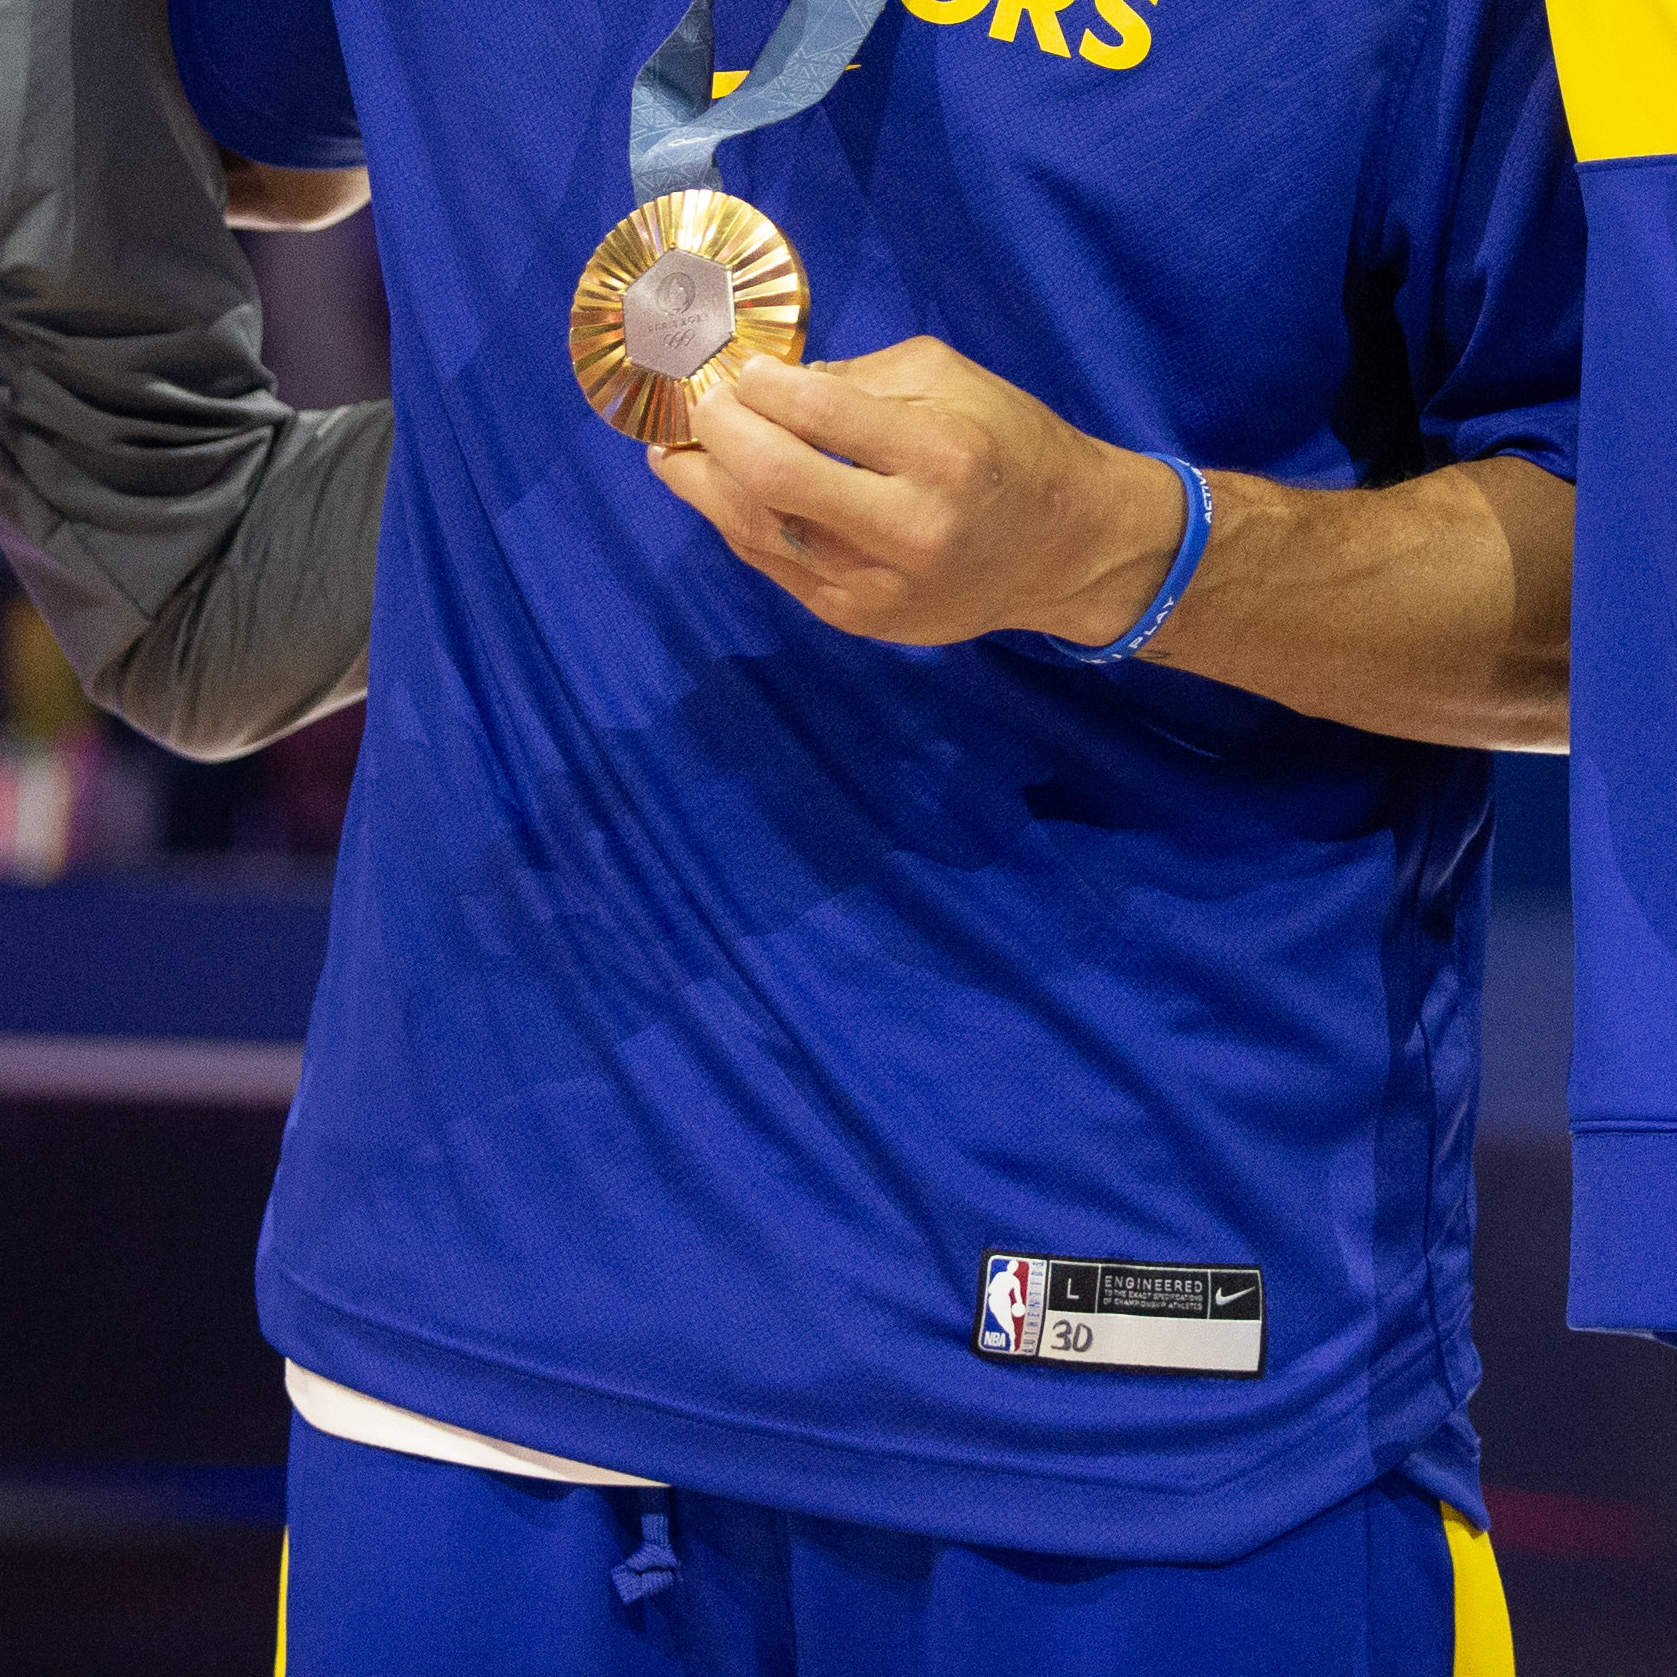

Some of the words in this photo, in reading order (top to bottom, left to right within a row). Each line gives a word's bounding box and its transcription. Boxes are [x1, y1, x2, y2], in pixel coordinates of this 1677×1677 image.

[1128, 596, 1174, 649] PLAY
[1067, 1277, 1080, 1300] L
[1105, 1275, 1203, 1293] ENGINEERED
[984, 1330, 1006, 1347] NBA
[1050, 1319, 1093, 1352] 30
